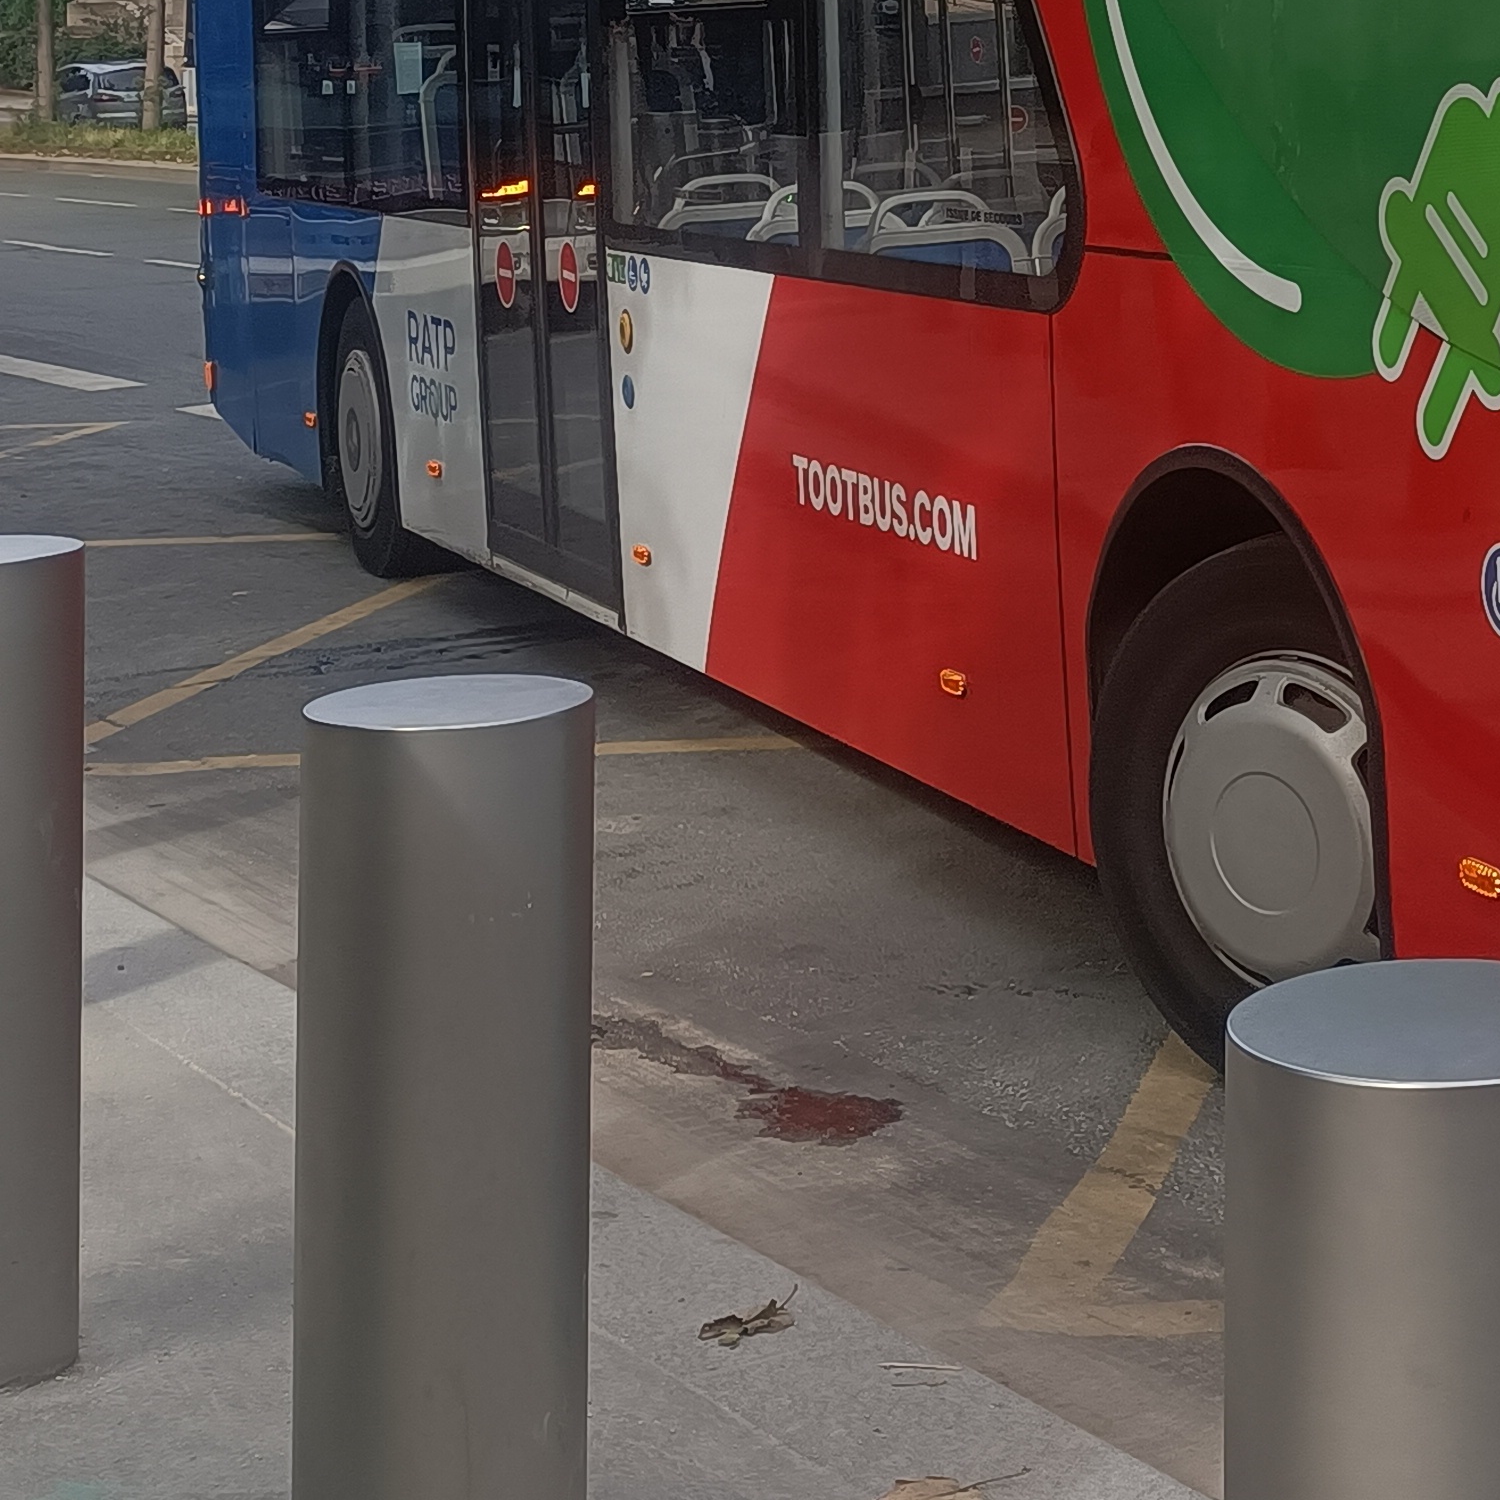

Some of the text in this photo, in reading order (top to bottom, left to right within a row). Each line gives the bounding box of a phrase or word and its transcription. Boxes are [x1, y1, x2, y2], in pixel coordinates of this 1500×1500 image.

[407, 309, 456, 372] RATP
[410, 374, 458, 424] GROUP
[792, 454, 977, 561] TOOTBUS.COM
